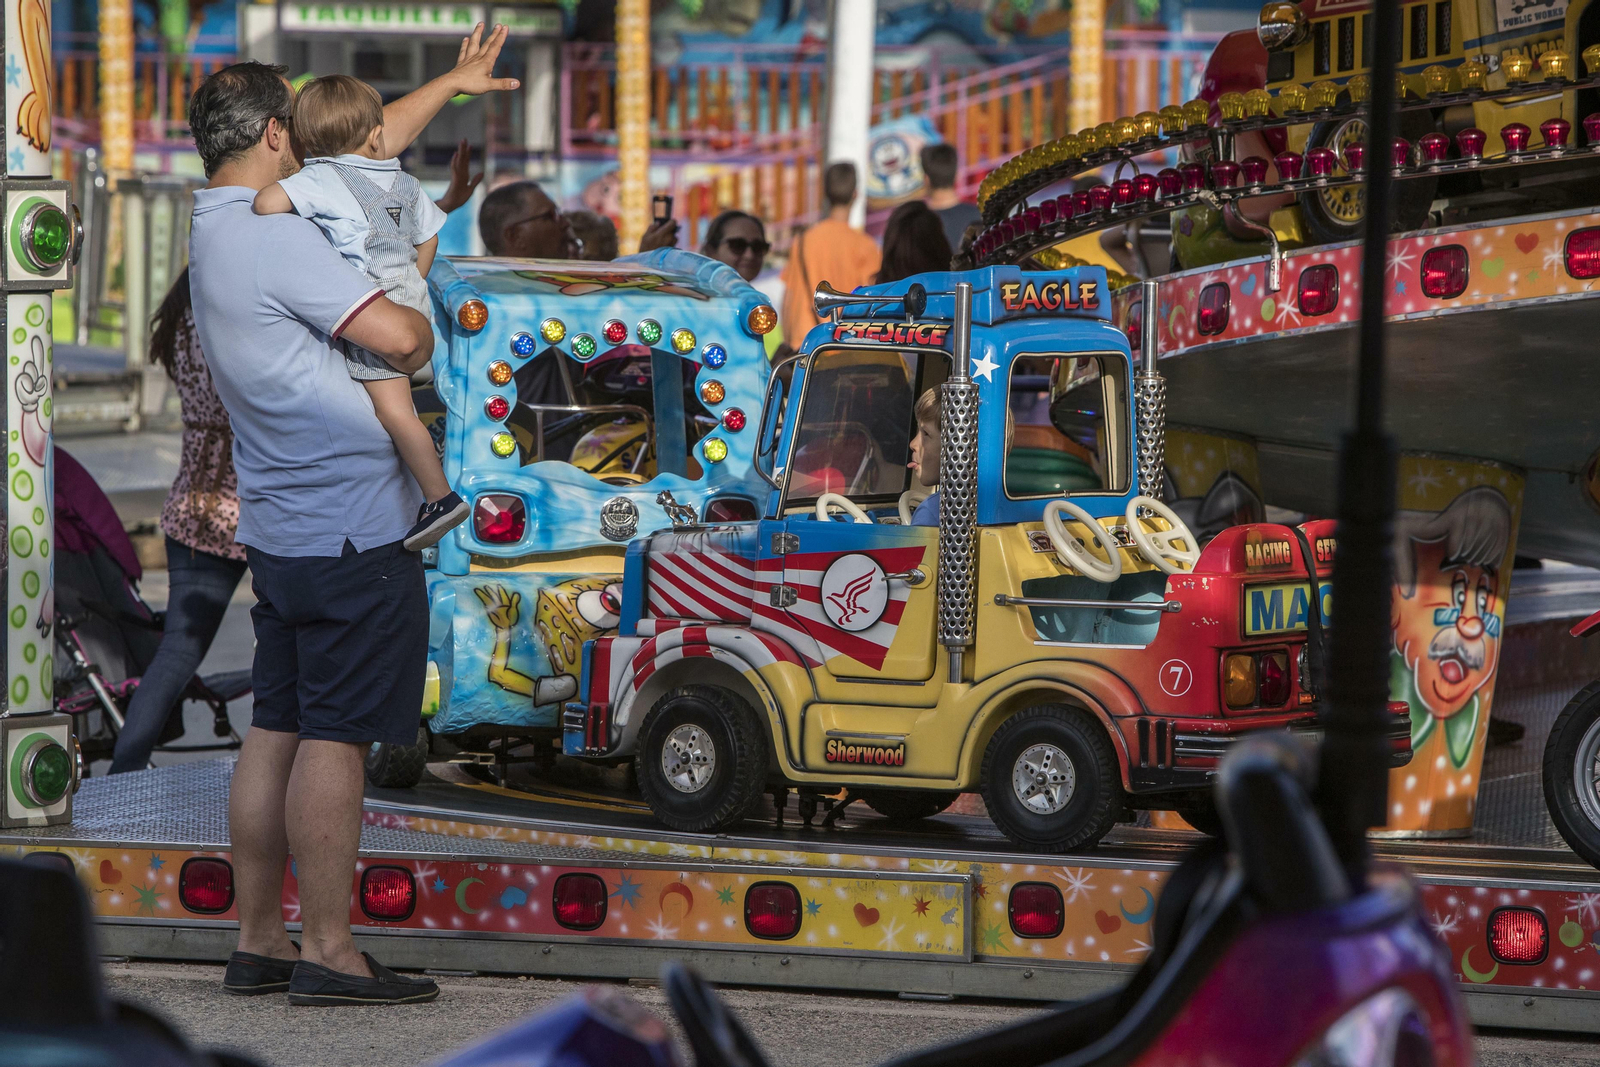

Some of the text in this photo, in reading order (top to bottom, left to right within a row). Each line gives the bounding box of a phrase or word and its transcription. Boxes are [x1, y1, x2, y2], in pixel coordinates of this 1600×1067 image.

[1503, 7, 1564, 28] PUBLIC WORKS
[1001, 281, 1099, 311] EAGLE
[1245, 540, 1292, 567] RACING
[1169, 666, 1183, 691] 7
[826, 739, 905, 766] Sherwood
